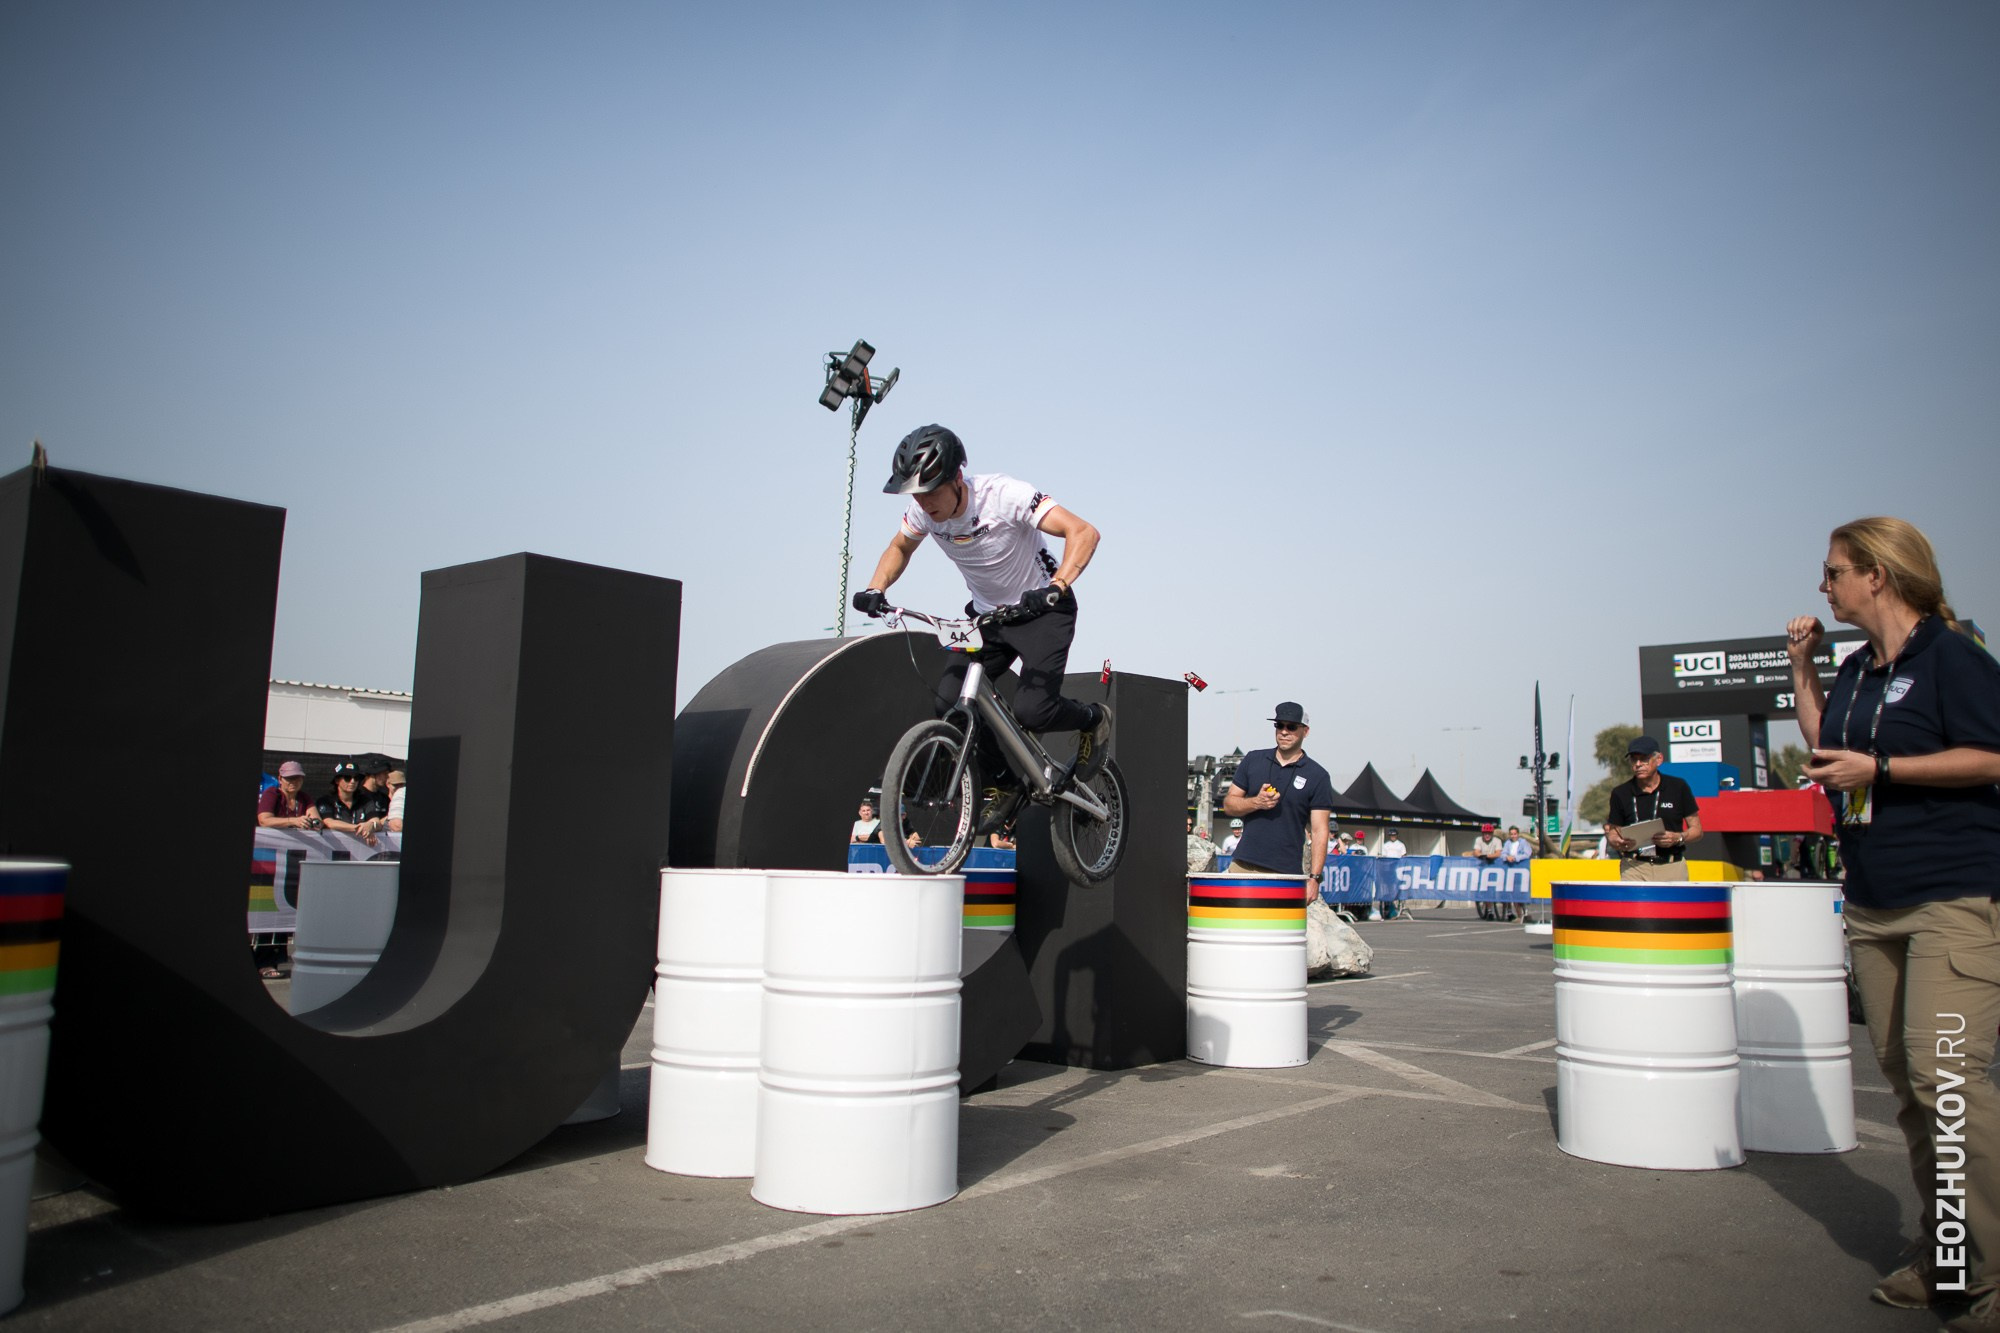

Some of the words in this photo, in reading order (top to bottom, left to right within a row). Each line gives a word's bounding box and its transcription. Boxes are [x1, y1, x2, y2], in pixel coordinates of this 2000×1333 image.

[950, 631, 970, 643] 4A
[1729, 654, 1747, 662] 2024
[1748, 651, 1776, 660] URBAN
[1683, 656, 1721, 671] UCI
[1729, 661, 1759, 670] WORLD
[1890, 685, 1906, 695] UCI
[1681, 724, 1713, 737] UCI
[1396, 866, 1530, 893] SHIMAN
